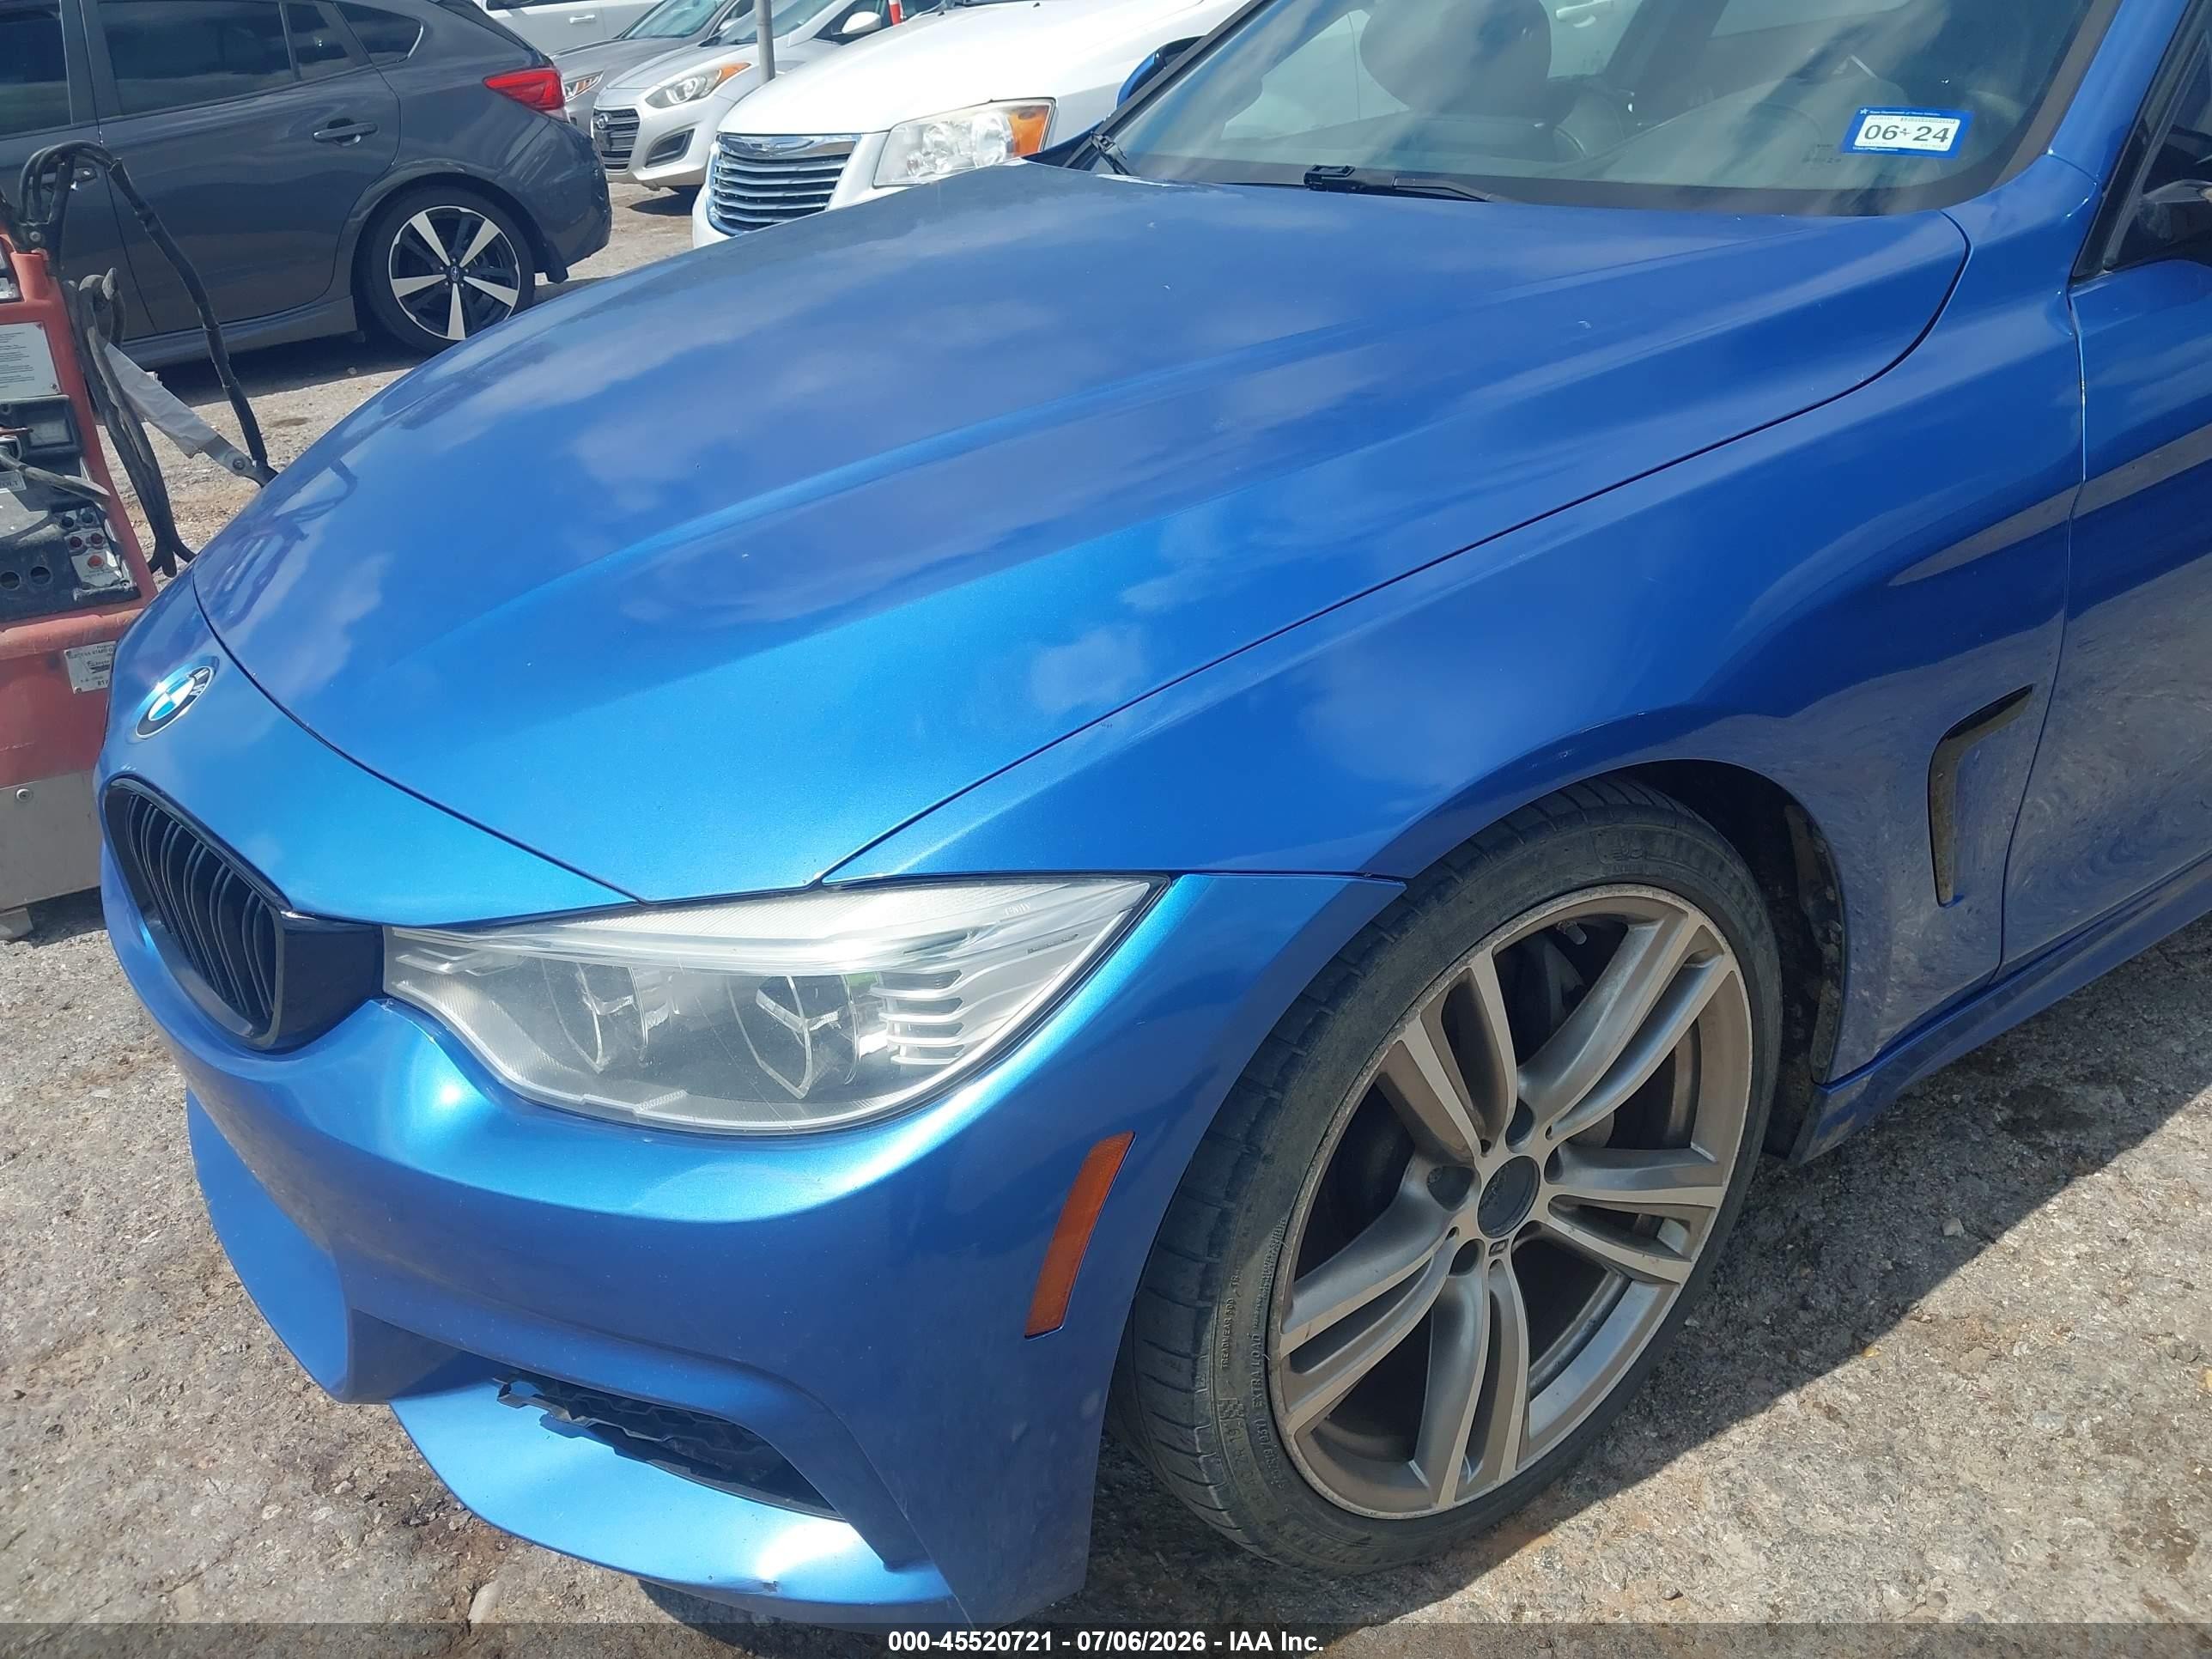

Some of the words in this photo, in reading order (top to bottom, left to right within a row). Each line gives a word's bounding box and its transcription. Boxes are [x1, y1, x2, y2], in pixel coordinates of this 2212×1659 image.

[1864, 125, 1899, 140] 06
[1912, 125, 1950, 143] 24
[1250, 1334, 1262, 1367] LOAD
[1250, 1370, 1263, 1408] EXTRA
